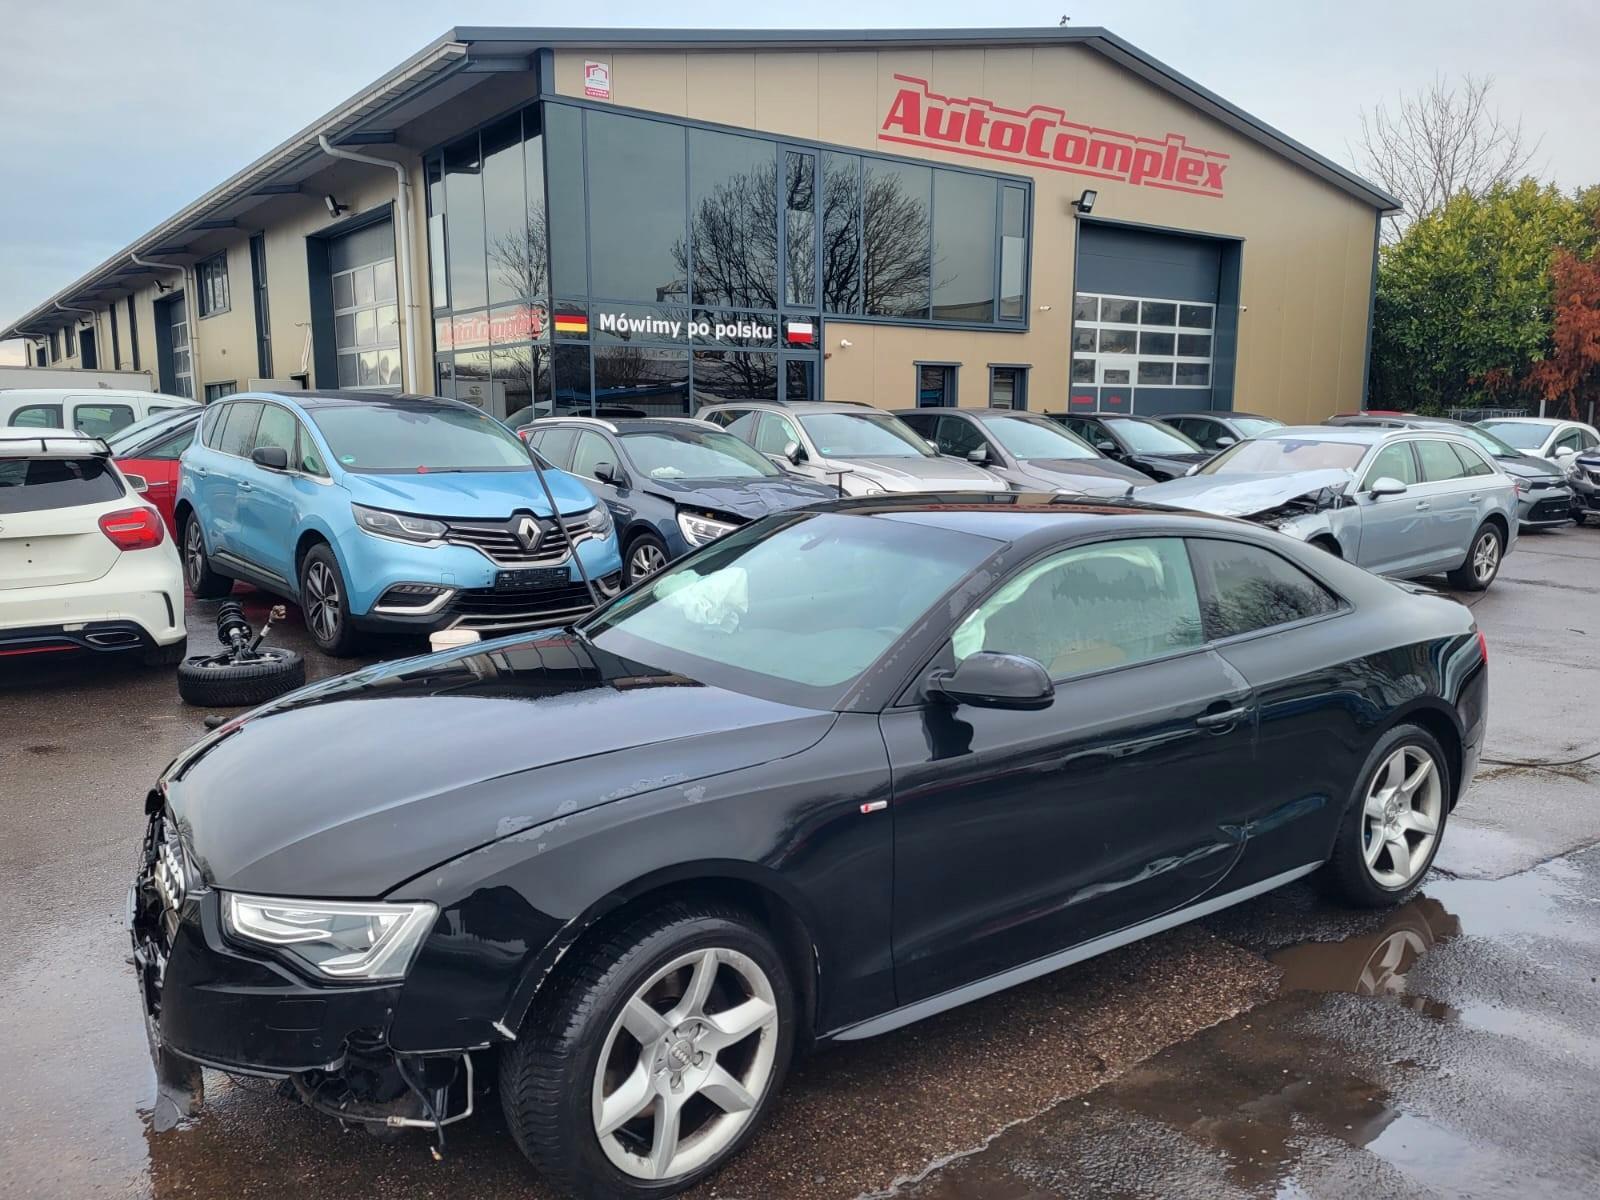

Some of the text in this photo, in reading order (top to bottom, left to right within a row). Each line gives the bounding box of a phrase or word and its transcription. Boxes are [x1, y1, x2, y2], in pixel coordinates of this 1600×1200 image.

[881, 88, 1228, 190] AutoComplex
[599, 313, 772, 340] Mówimy po polsku
